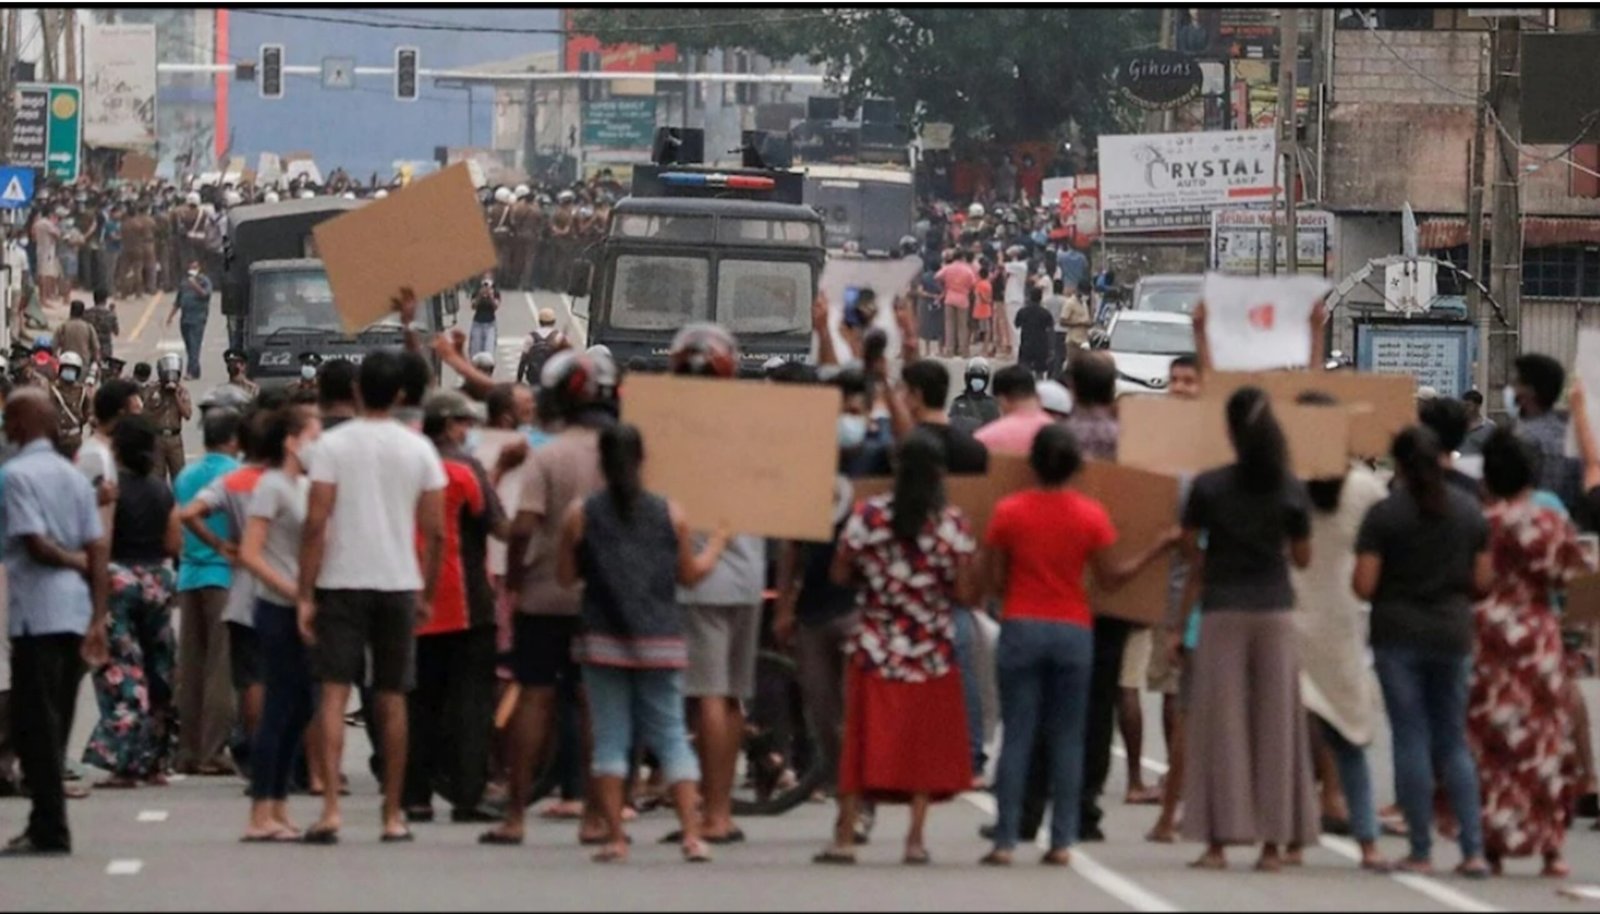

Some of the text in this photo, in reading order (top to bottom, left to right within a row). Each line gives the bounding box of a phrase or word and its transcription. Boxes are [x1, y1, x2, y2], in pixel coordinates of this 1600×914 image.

[1143, 158, 1264, 190] CRYSTAL
[1176, 178, 1207, 188] AUTO
[259, 351, 292, 366] Ex2
